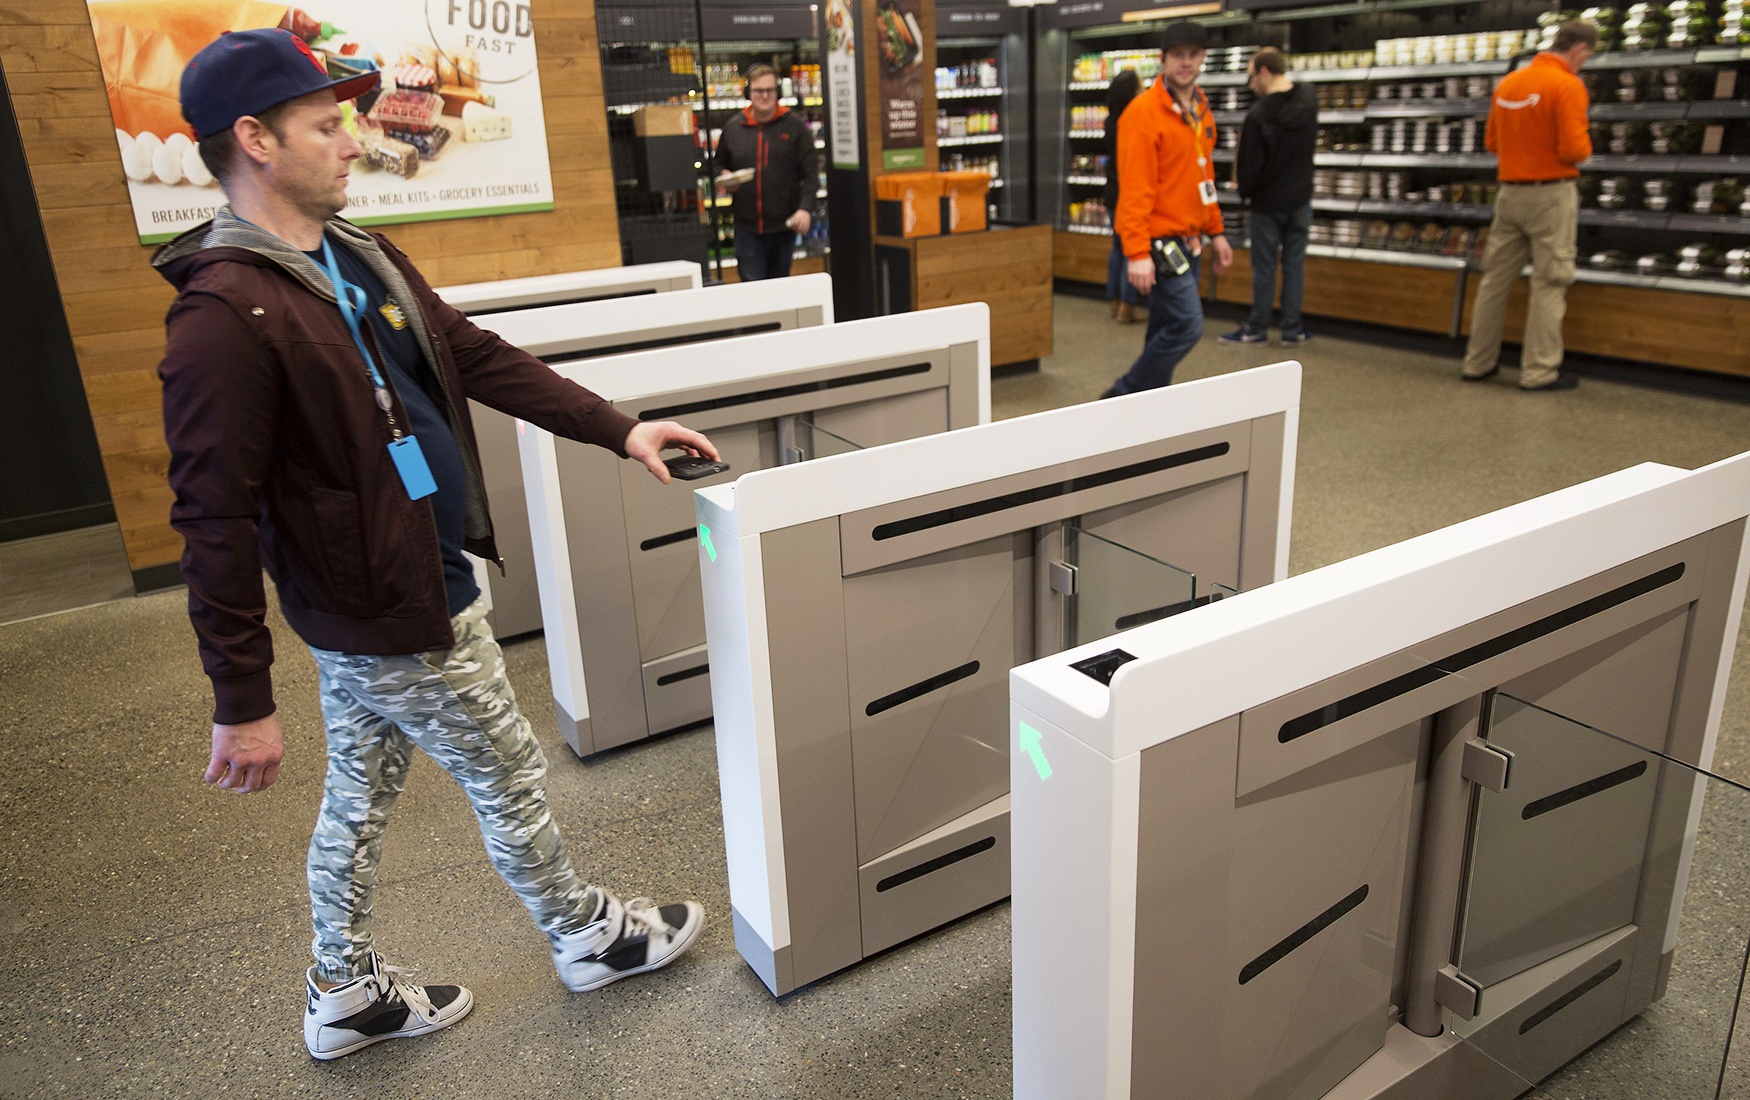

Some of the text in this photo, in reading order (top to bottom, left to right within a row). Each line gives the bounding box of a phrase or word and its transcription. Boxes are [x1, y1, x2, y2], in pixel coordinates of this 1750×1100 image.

[448, 0, 534, 38] FOOD
[465, 35, 516, 55] FAST
[152, 207, 216, 224] BREAKFAST
[379, 193, 404, 206] MEAL
[408, 191, 430, 204] KITS
[439, 187, 483, 201] GROCERY
[486, 182, 540, 198] ESSENTIALS
